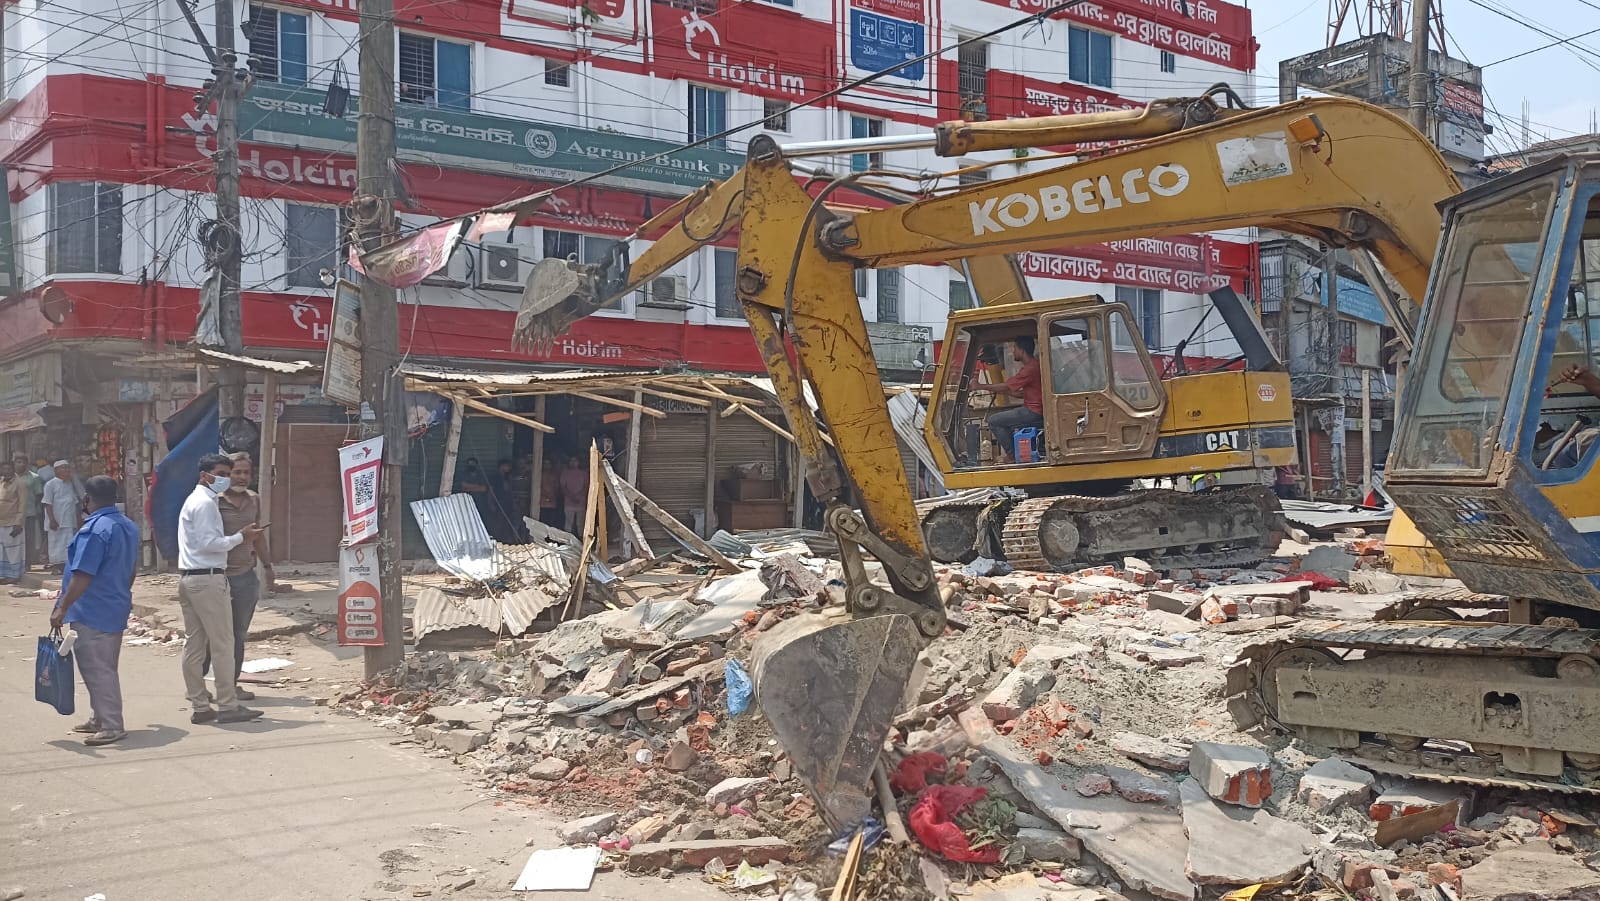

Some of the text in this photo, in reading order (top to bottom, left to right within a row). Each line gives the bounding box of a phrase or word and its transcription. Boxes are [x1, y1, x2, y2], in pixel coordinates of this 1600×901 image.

[1197, 2, 1217, 24] নিন
[1114, 11, 1137, 35] এর
[1176, 30, 1231, 61] হোলসিম
[707, 51, 805, 96] Holcim
[567, 140, 646, 161] Agrani
[655, 153, 711, 173] Bank
[968, 162, 1190, 236] KOBELCO
[562, 339, 622, 358] Holcim
[1206, 431, 1239, 451] CAT
